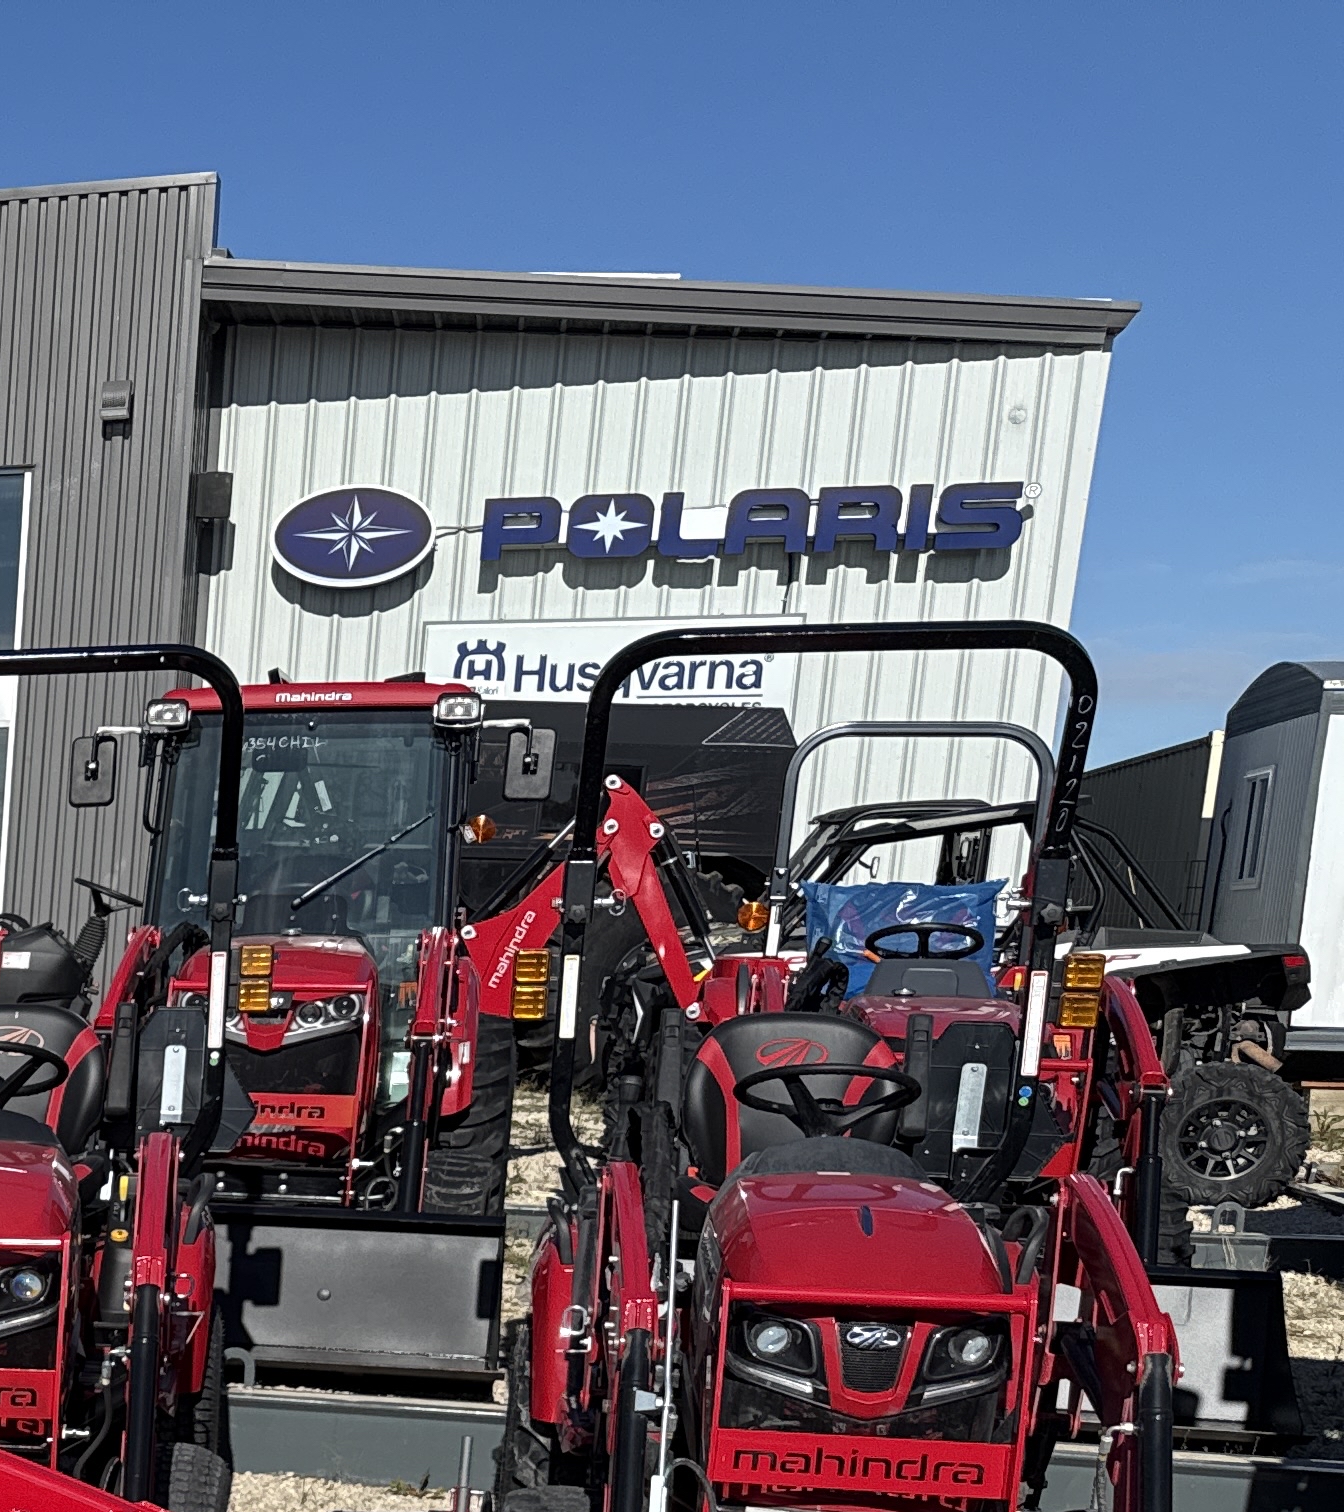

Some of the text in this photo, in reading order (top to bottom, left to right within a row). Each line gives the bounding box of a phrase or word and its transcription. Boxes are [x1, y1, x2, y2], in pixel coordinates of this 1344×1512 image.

[480, 481, 1031, 561] POLARIS
[275, 692, 352, 702] Mahindra
[488, 910, 536, 989] mahindra
[732, 1446, 985, 1485] mahindra
